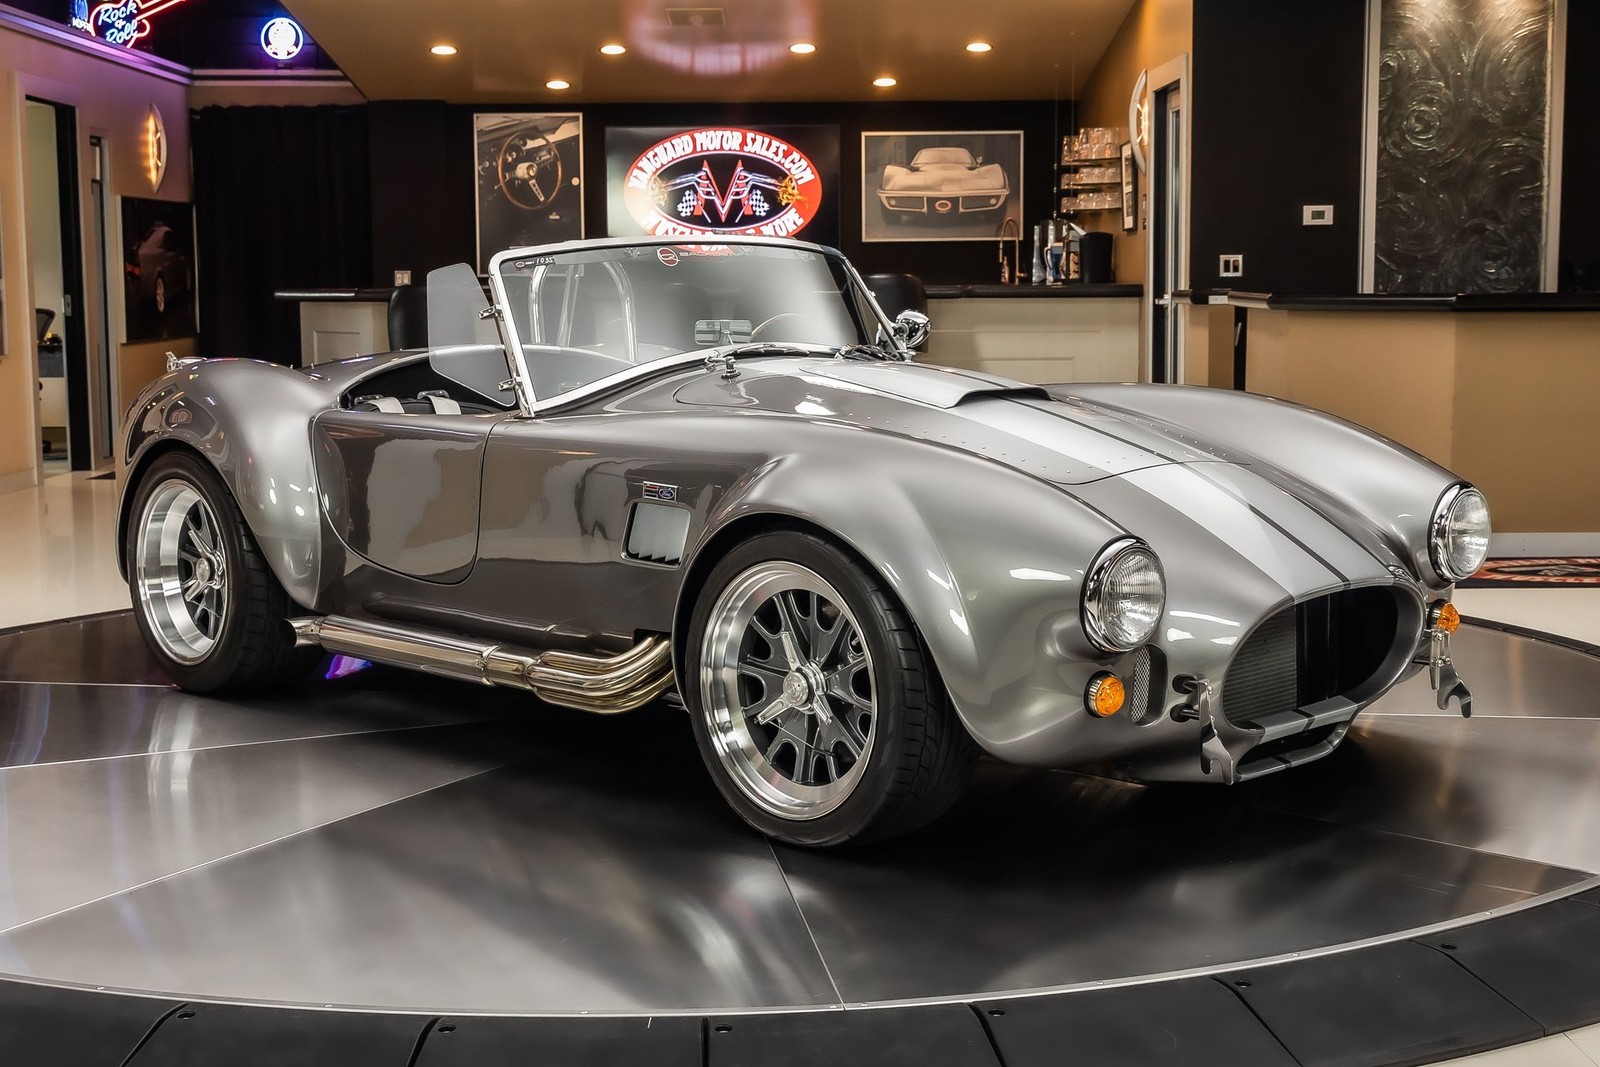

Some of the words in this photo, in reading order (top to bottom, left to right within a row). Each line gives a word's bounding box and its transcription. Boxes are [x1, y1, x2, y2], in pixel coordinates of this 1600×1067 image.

[98, 0, 138, 26] Rock
[105, 19, 138, 43] Roll
[627, 134, 694, 189] VANGUARD
[693, 130, 743, 152] MOTOR
[743, 132, 816, 185] SALES.COM
